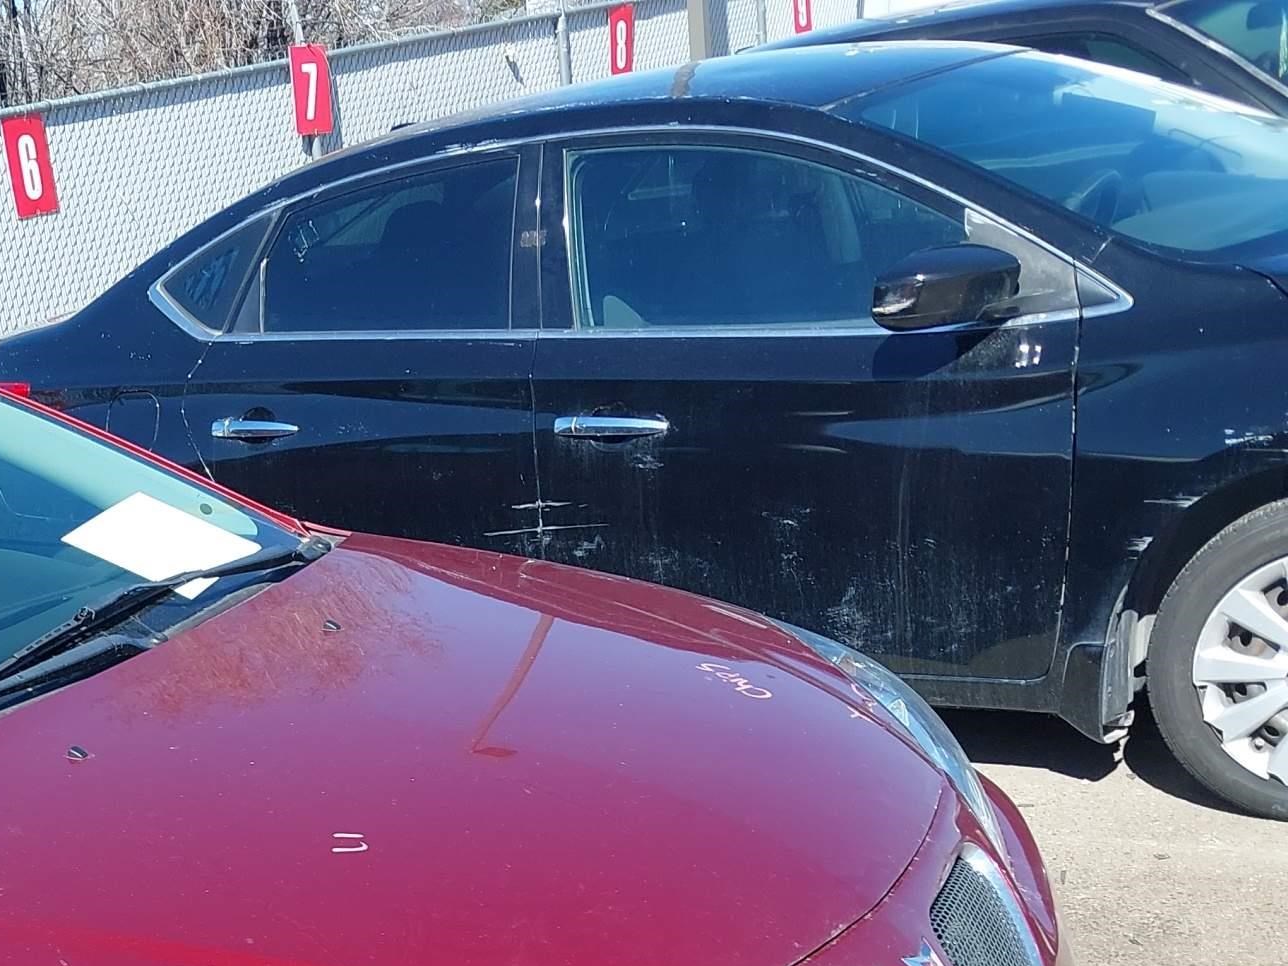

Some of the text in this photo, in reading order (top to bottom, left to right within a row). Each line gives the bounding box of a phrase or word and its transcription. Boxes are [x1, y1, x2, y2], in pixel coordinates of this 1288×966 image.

[616, 19, 627, 70] 8
[301, 62, 318, 121] 7
[17, 134, 43, 200] 6
